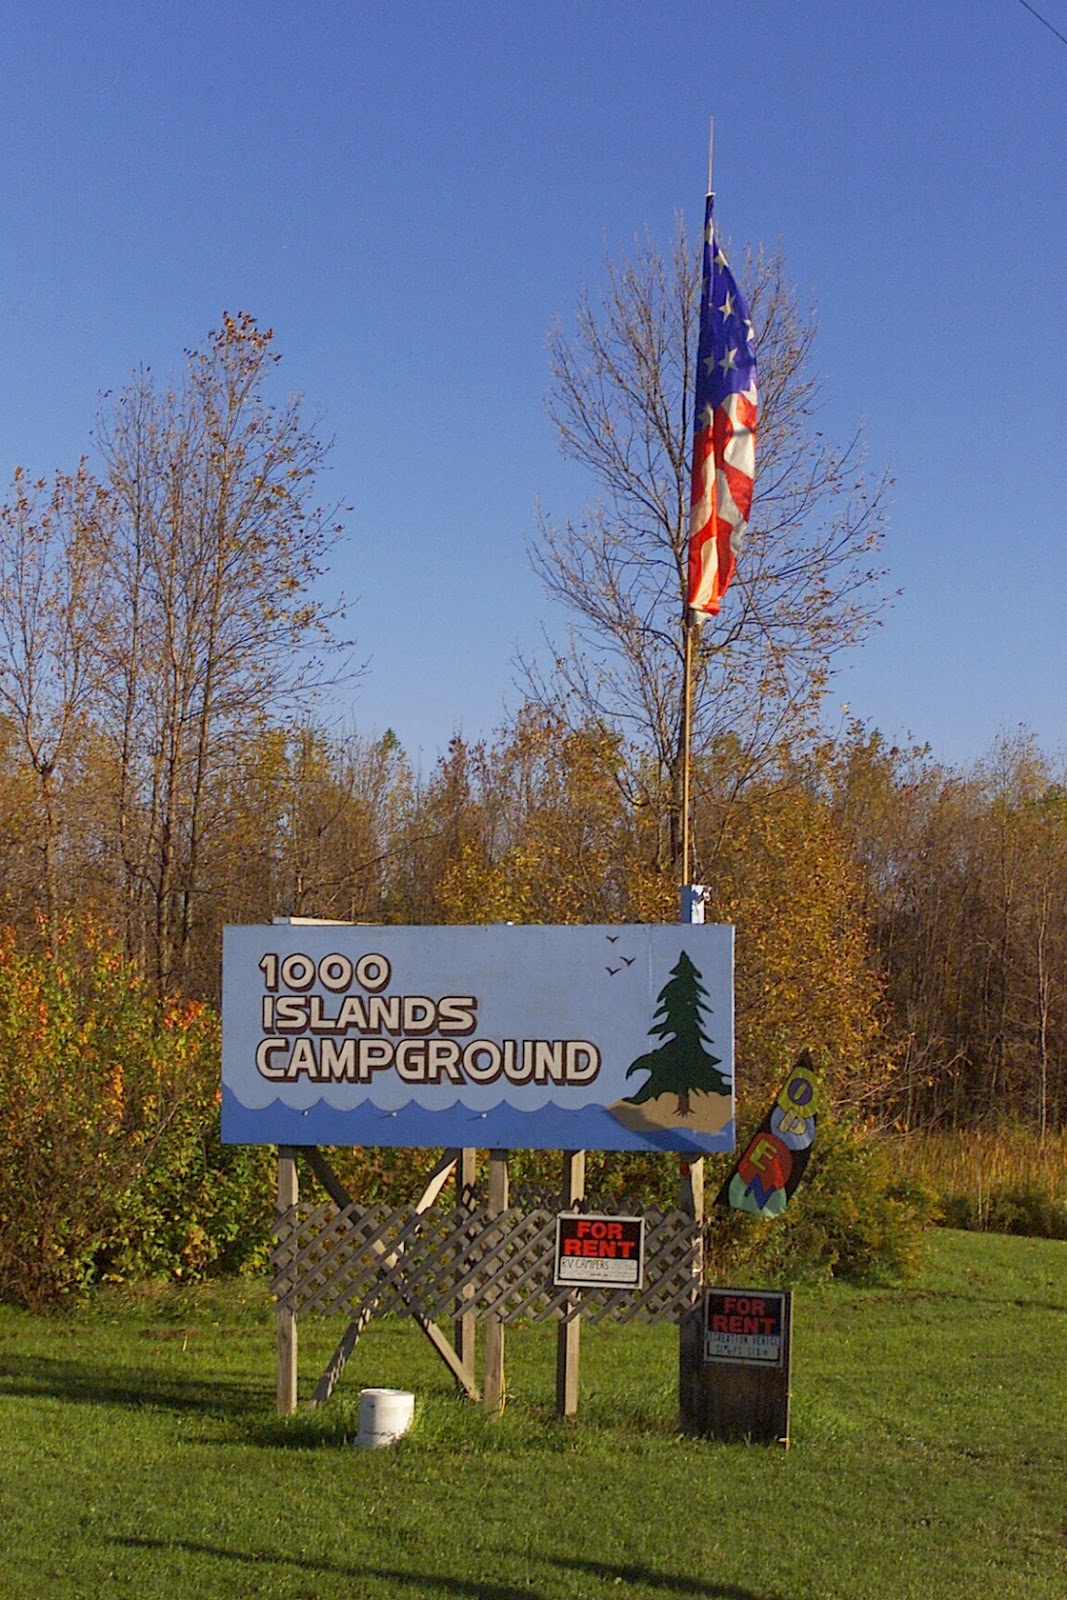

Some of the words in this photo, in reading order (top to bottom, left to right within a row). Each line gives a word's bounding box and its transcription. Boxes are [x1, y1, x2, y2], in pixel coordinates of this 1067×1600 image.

[257, 952, 392, 993] 1000
[261, 994, 478, 1036] ISLANDS
[254, 1036, 602, 1086] CAMPGROUND
[744, 1077, 813, 1210] OPEN
[577, 1221, 623, 1239] FOR
[563, 1238, 635, 1258] RENT
[724, 1297, 766, 1316] FOR
[711, 1314, 776, 1336] RENT
